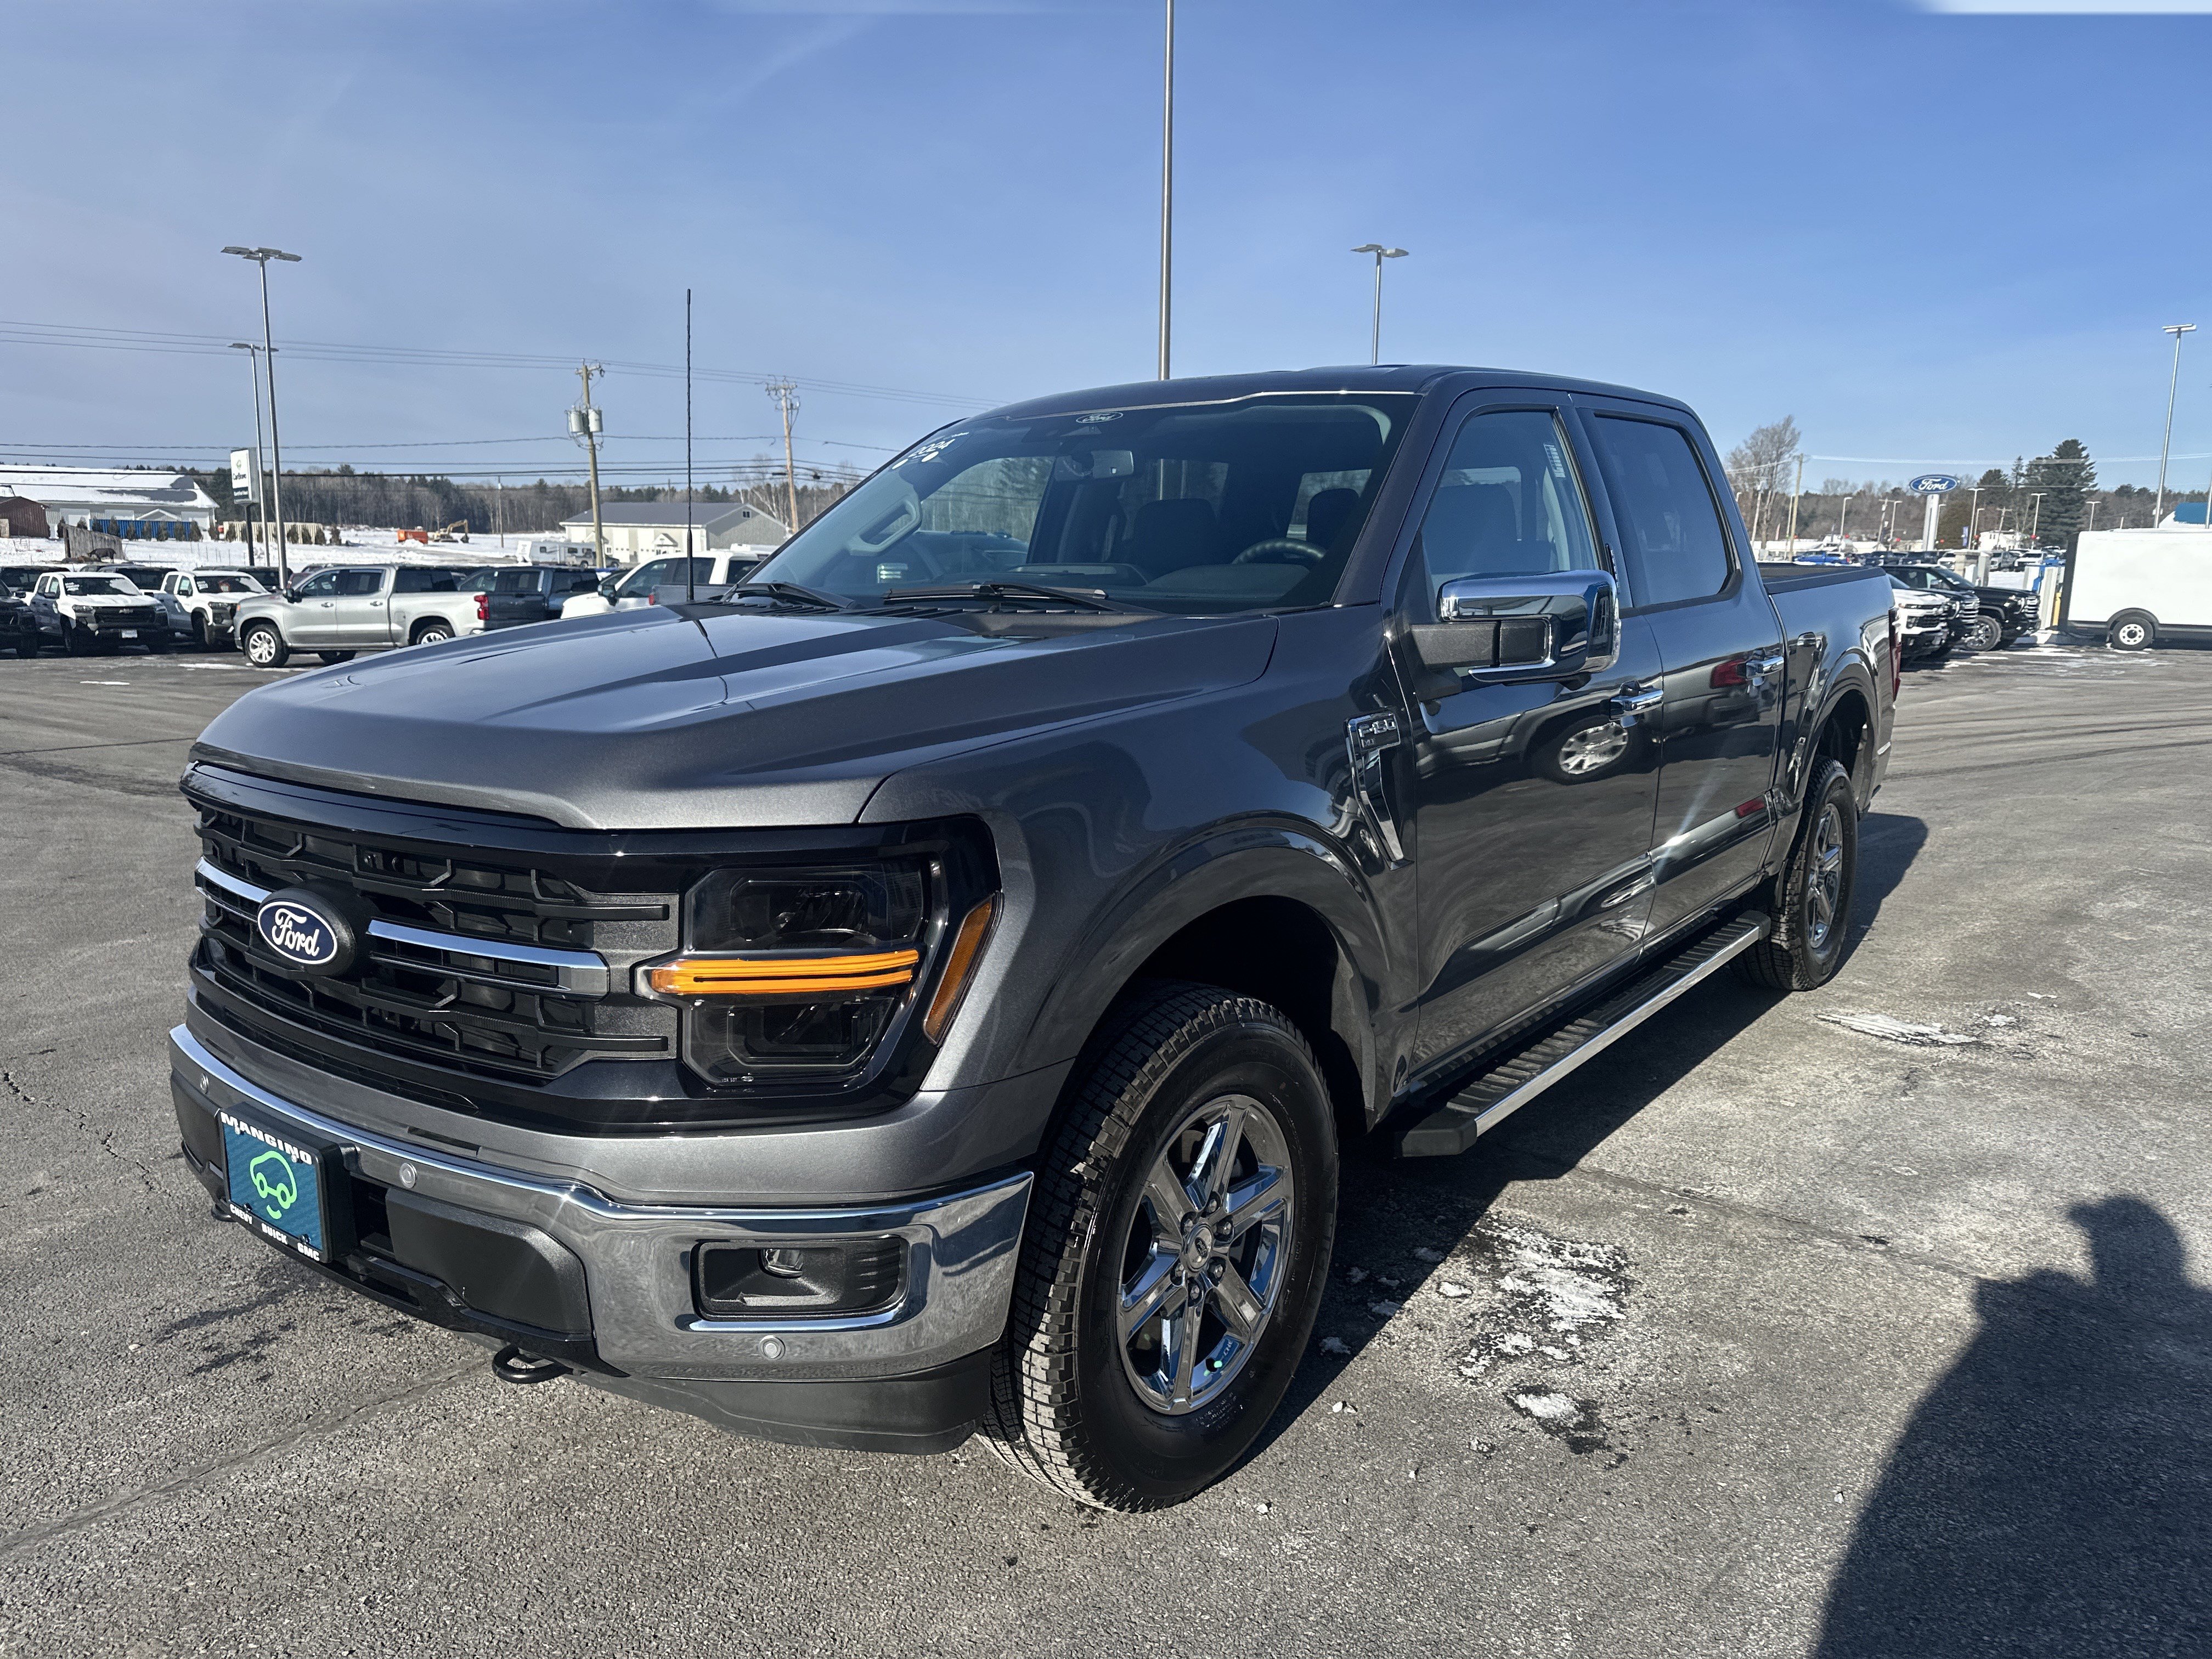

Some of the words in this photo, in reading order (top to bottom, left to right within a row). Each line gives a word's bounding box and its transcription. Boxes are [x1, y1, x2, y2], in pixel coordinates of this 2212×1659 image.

[1918, 477, 1949, 490] Ford
[272, 908, 320, 957] Ford
[221, 1112, 312, 1165] MANGINO
[229, 1204, 252, 1224] CHEVY
[261, 1223, 288, 1245] BUICK
[297, 1242, 320, 1261] GMC
